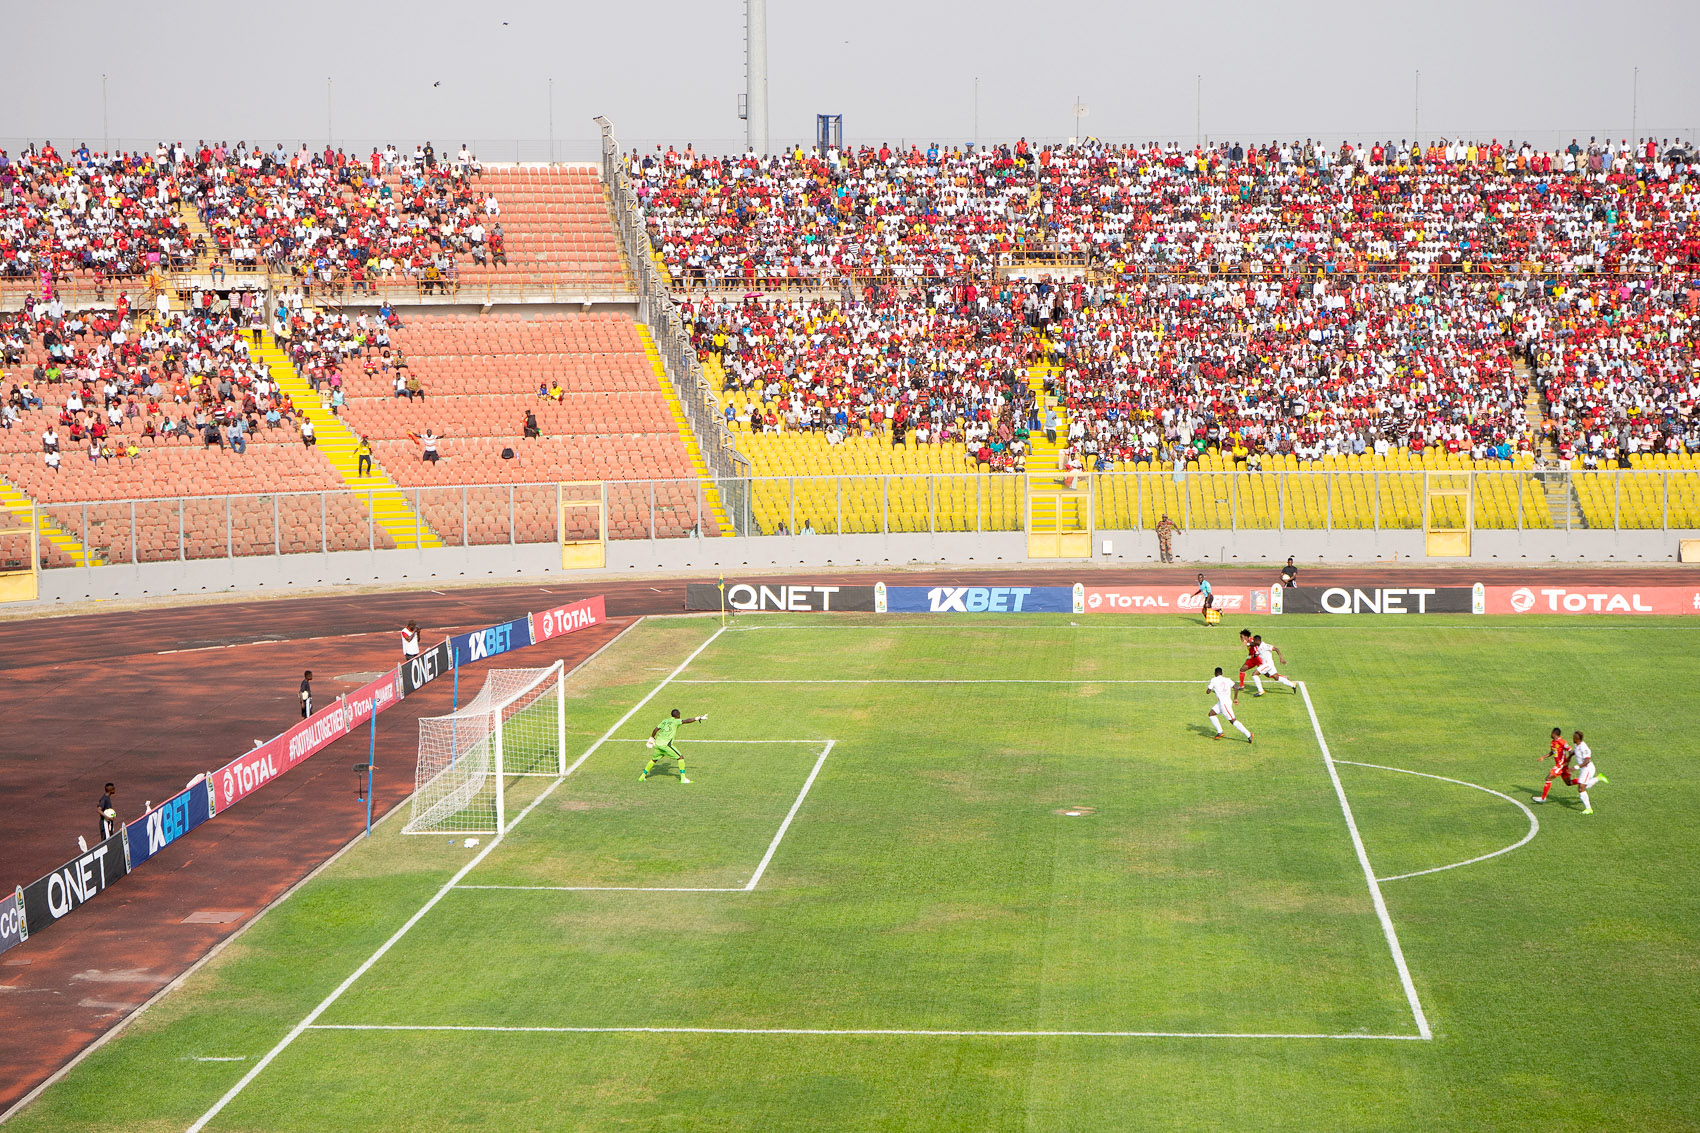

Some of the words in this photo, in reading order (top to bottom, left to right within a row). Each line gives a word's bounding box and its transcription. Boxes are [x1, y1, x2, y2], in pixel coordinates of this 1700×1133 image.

[728, 584, 839, 611] QNET
[928, 587, 1031, 612] 1XBET
[1105, 593, 1169, 608] TOTAL
[1177, 593, 1243, 609] QURTZ
[1321, 587, 1435, 614] QNET
[1541, 589, 1653, 612] TOTAL
[554, 606, 596, 632] TOTAL
[468, 623, 513, 661] 1XBET
[411, 647, 439, 690] QNET
[353, 697, 373, 718] TOTAL
[233, 754, 278, 795] TOTAL
[147, 791, 191, 856] 1XBET
[48, 845, 108, 919] QNET
